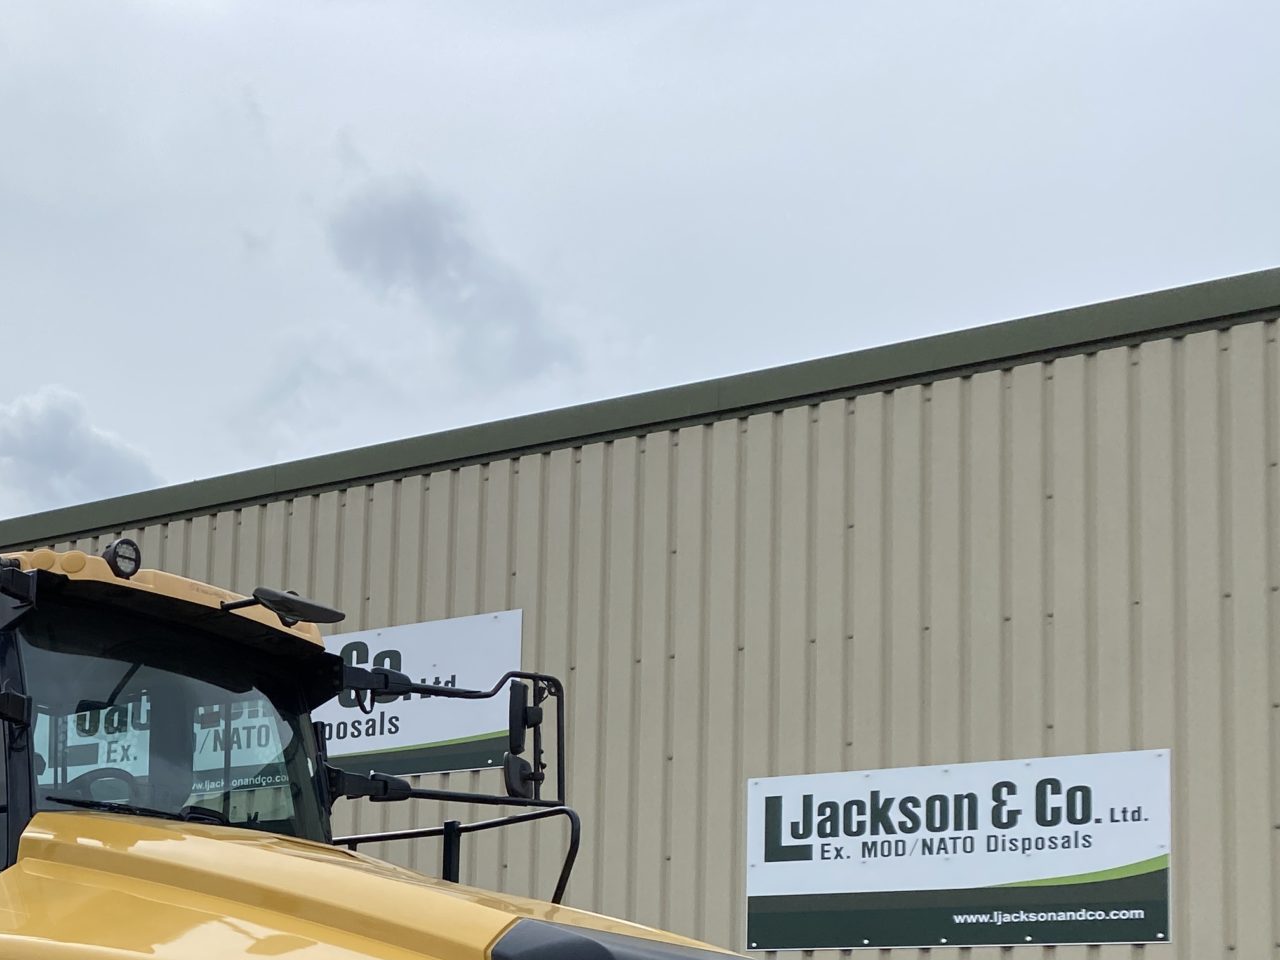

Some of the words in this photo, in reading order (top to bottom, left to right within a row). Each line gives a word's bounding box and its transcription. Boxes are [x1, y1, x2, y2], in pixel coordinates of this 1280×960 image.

[991, 780, 1022, 830] &
[1034, 777, 1103, 827] Co.
[1109, 806, 1150, 824] Ltd.
[820, 843, 851, 861] Ex.
[861, 835, 975, 859] MOD/NATO
[986, 830, 1093, 855] Disposals
[953, 908, 1145, 926] www.ljacksonandco.com
